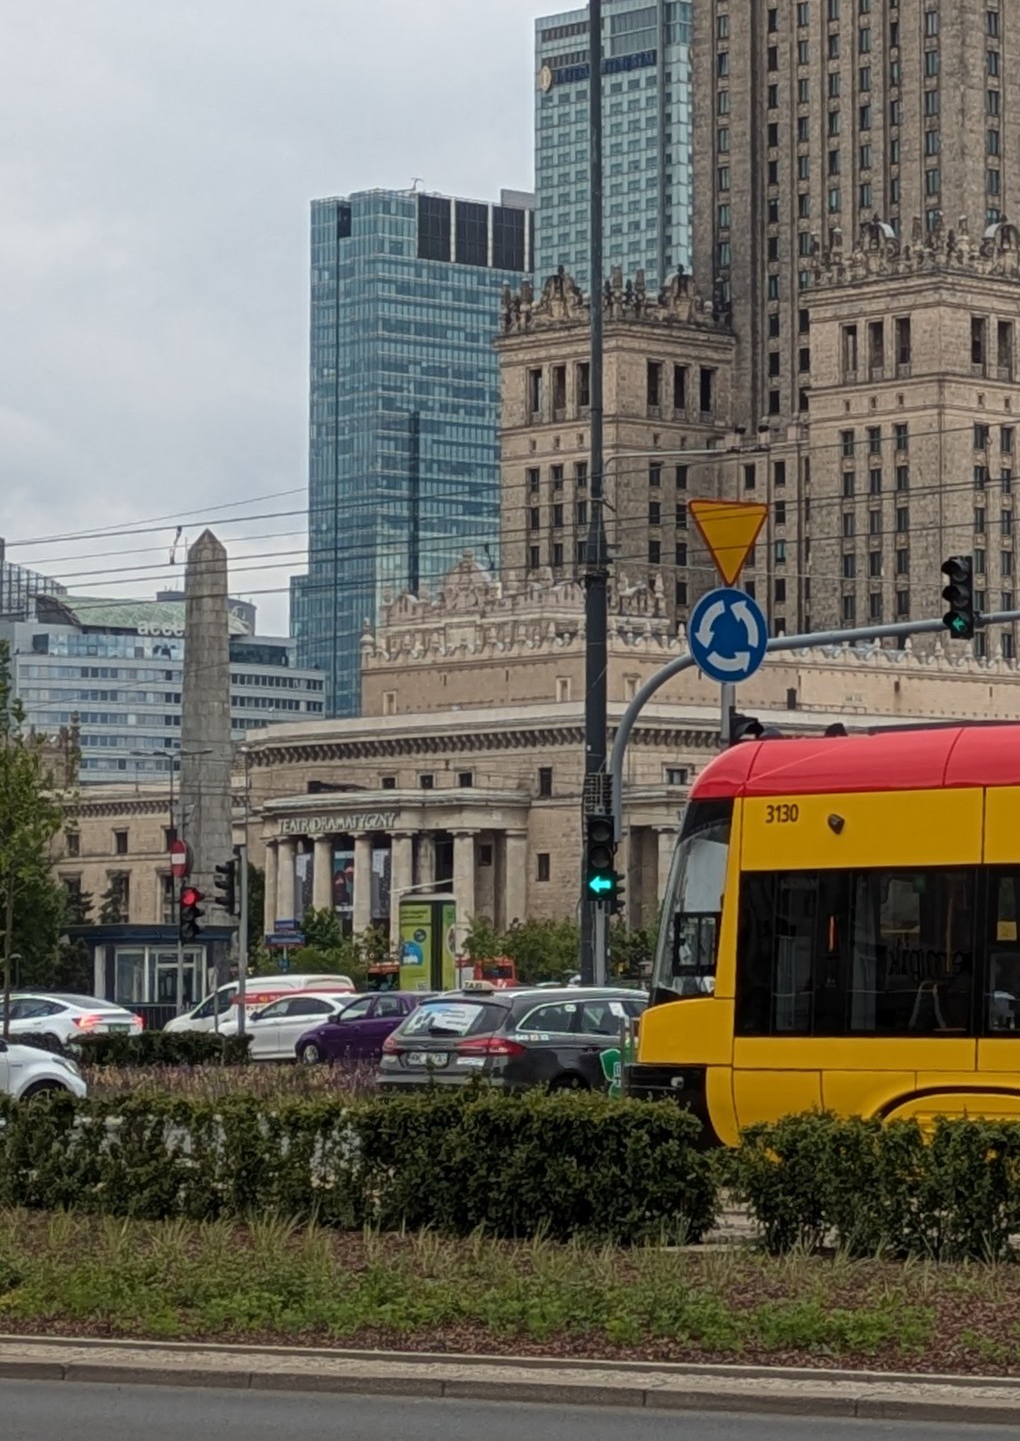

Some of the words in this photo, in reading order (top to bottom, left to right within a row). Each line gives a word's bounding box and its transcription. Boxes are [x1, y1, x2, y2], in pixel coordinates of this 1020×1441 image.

[137, 620, 185, 637] acce
[277, 817, 309, 834] TEATR
[312, 812, 396, 832] DRAMATYCZNY
[765, 803, 800, 824] 3130
